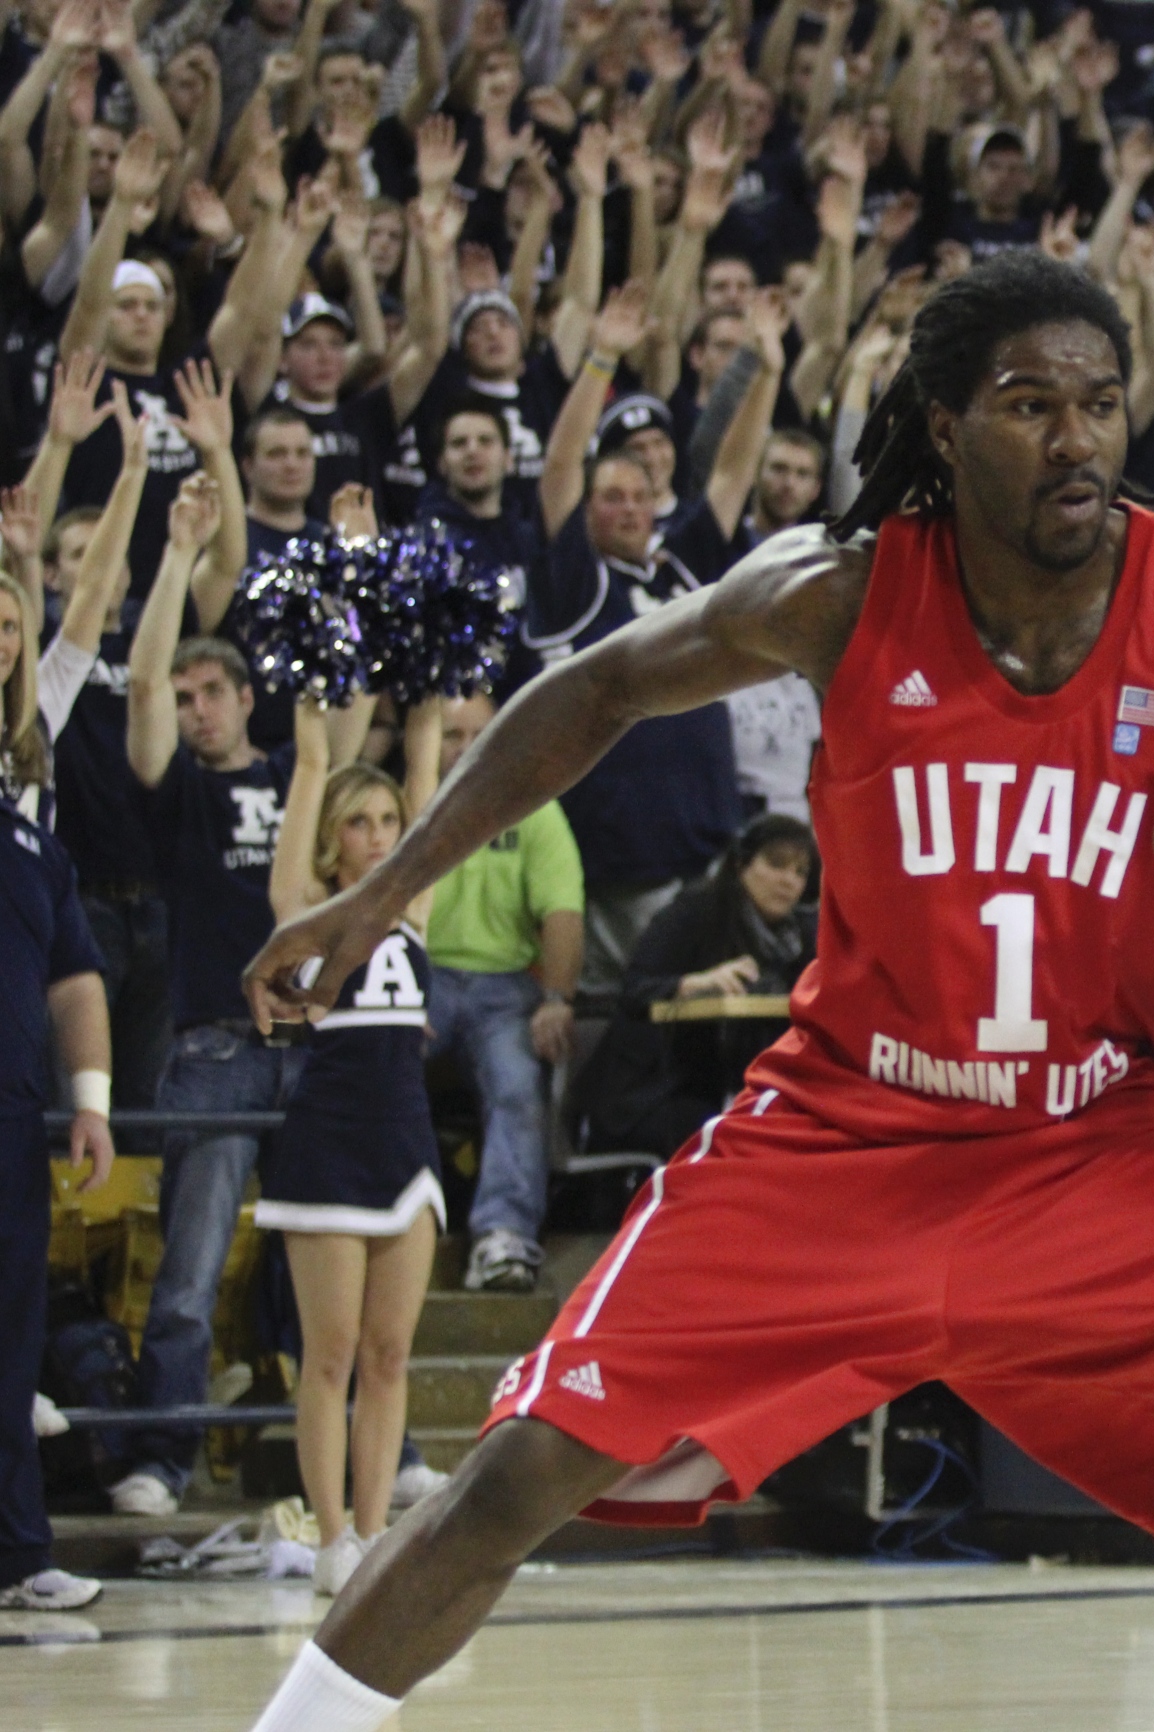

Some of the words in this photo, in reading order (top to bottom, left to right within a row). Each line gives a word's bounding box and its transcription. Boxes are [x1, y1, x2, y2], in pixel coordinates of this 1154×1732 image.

[893, 762, 1147, 899] UTAH
[354, 934, 425, 1007] A
[977, 893, 1047, 1052] 1
[869, 1032, 1029, 1109] RUNNIN'
[1046, 1038, 1129, 1116] UTES
